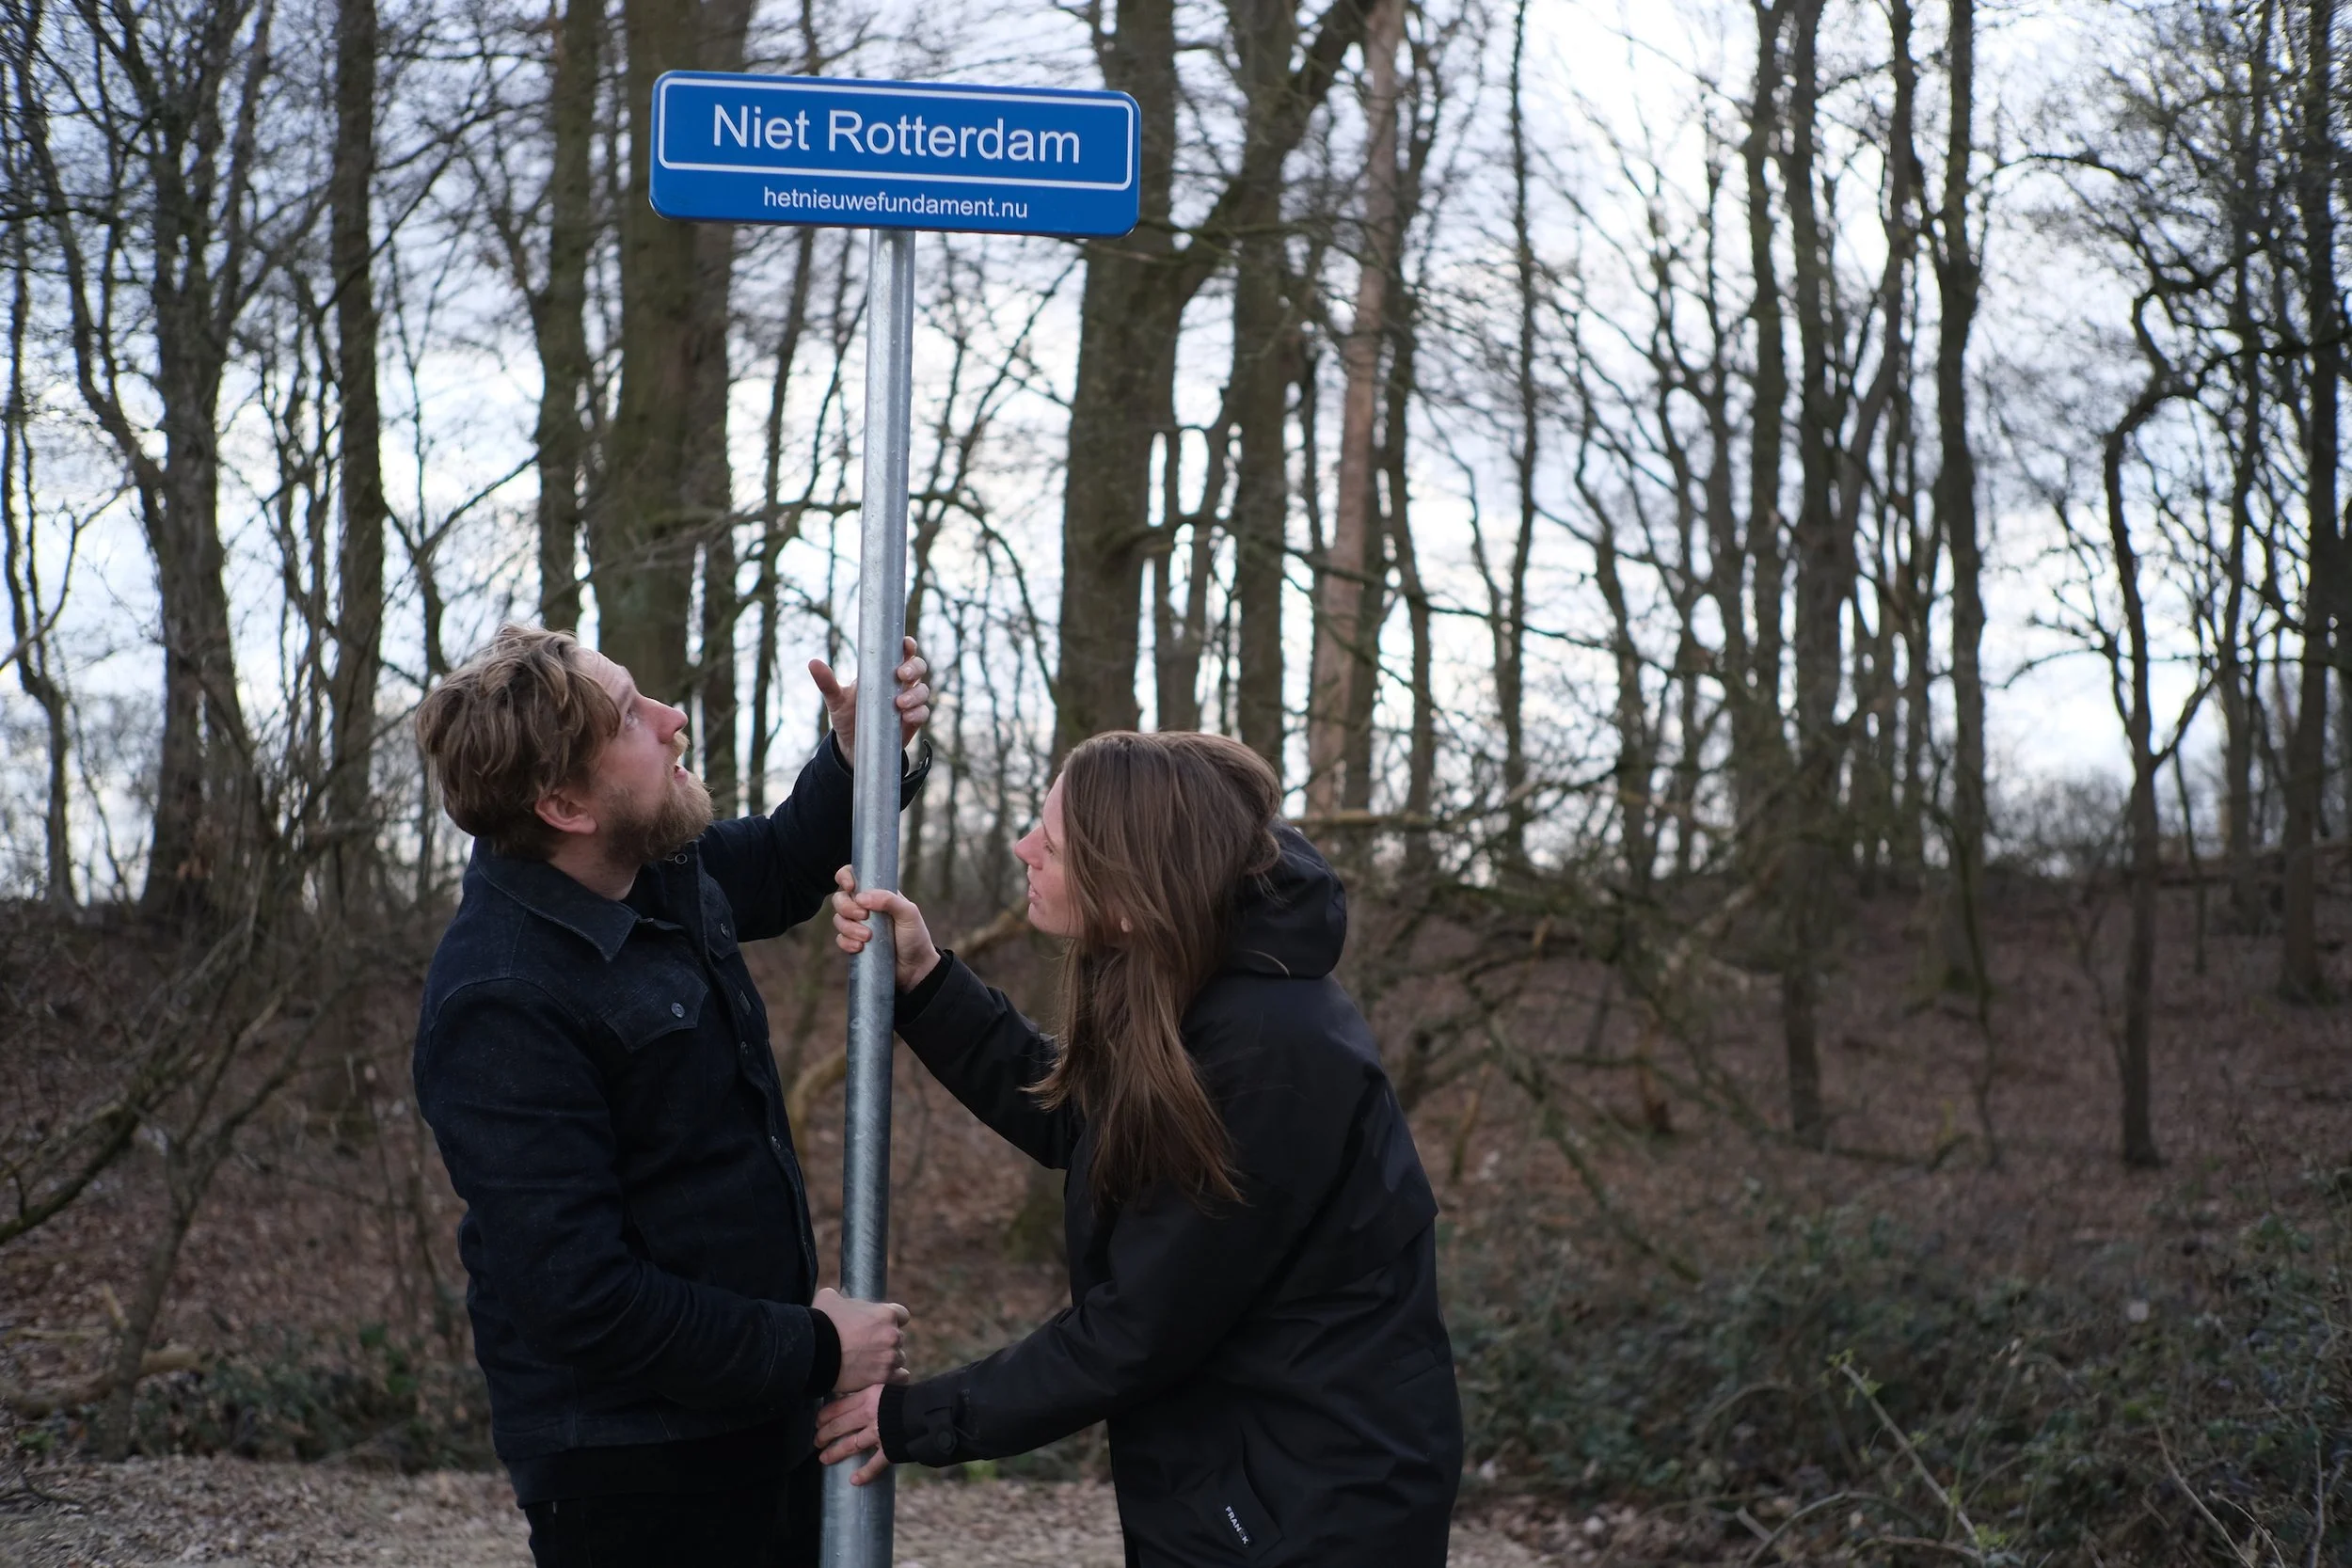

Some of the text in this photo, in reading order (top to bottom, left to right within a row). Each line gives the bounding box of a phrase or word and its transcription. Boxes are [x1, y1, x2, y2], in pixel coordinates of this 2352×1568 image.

[713, 104, 1080, 164] Niet Rotterdam
[763, 186, 1028, 218] hetnieuwefundament.nu
